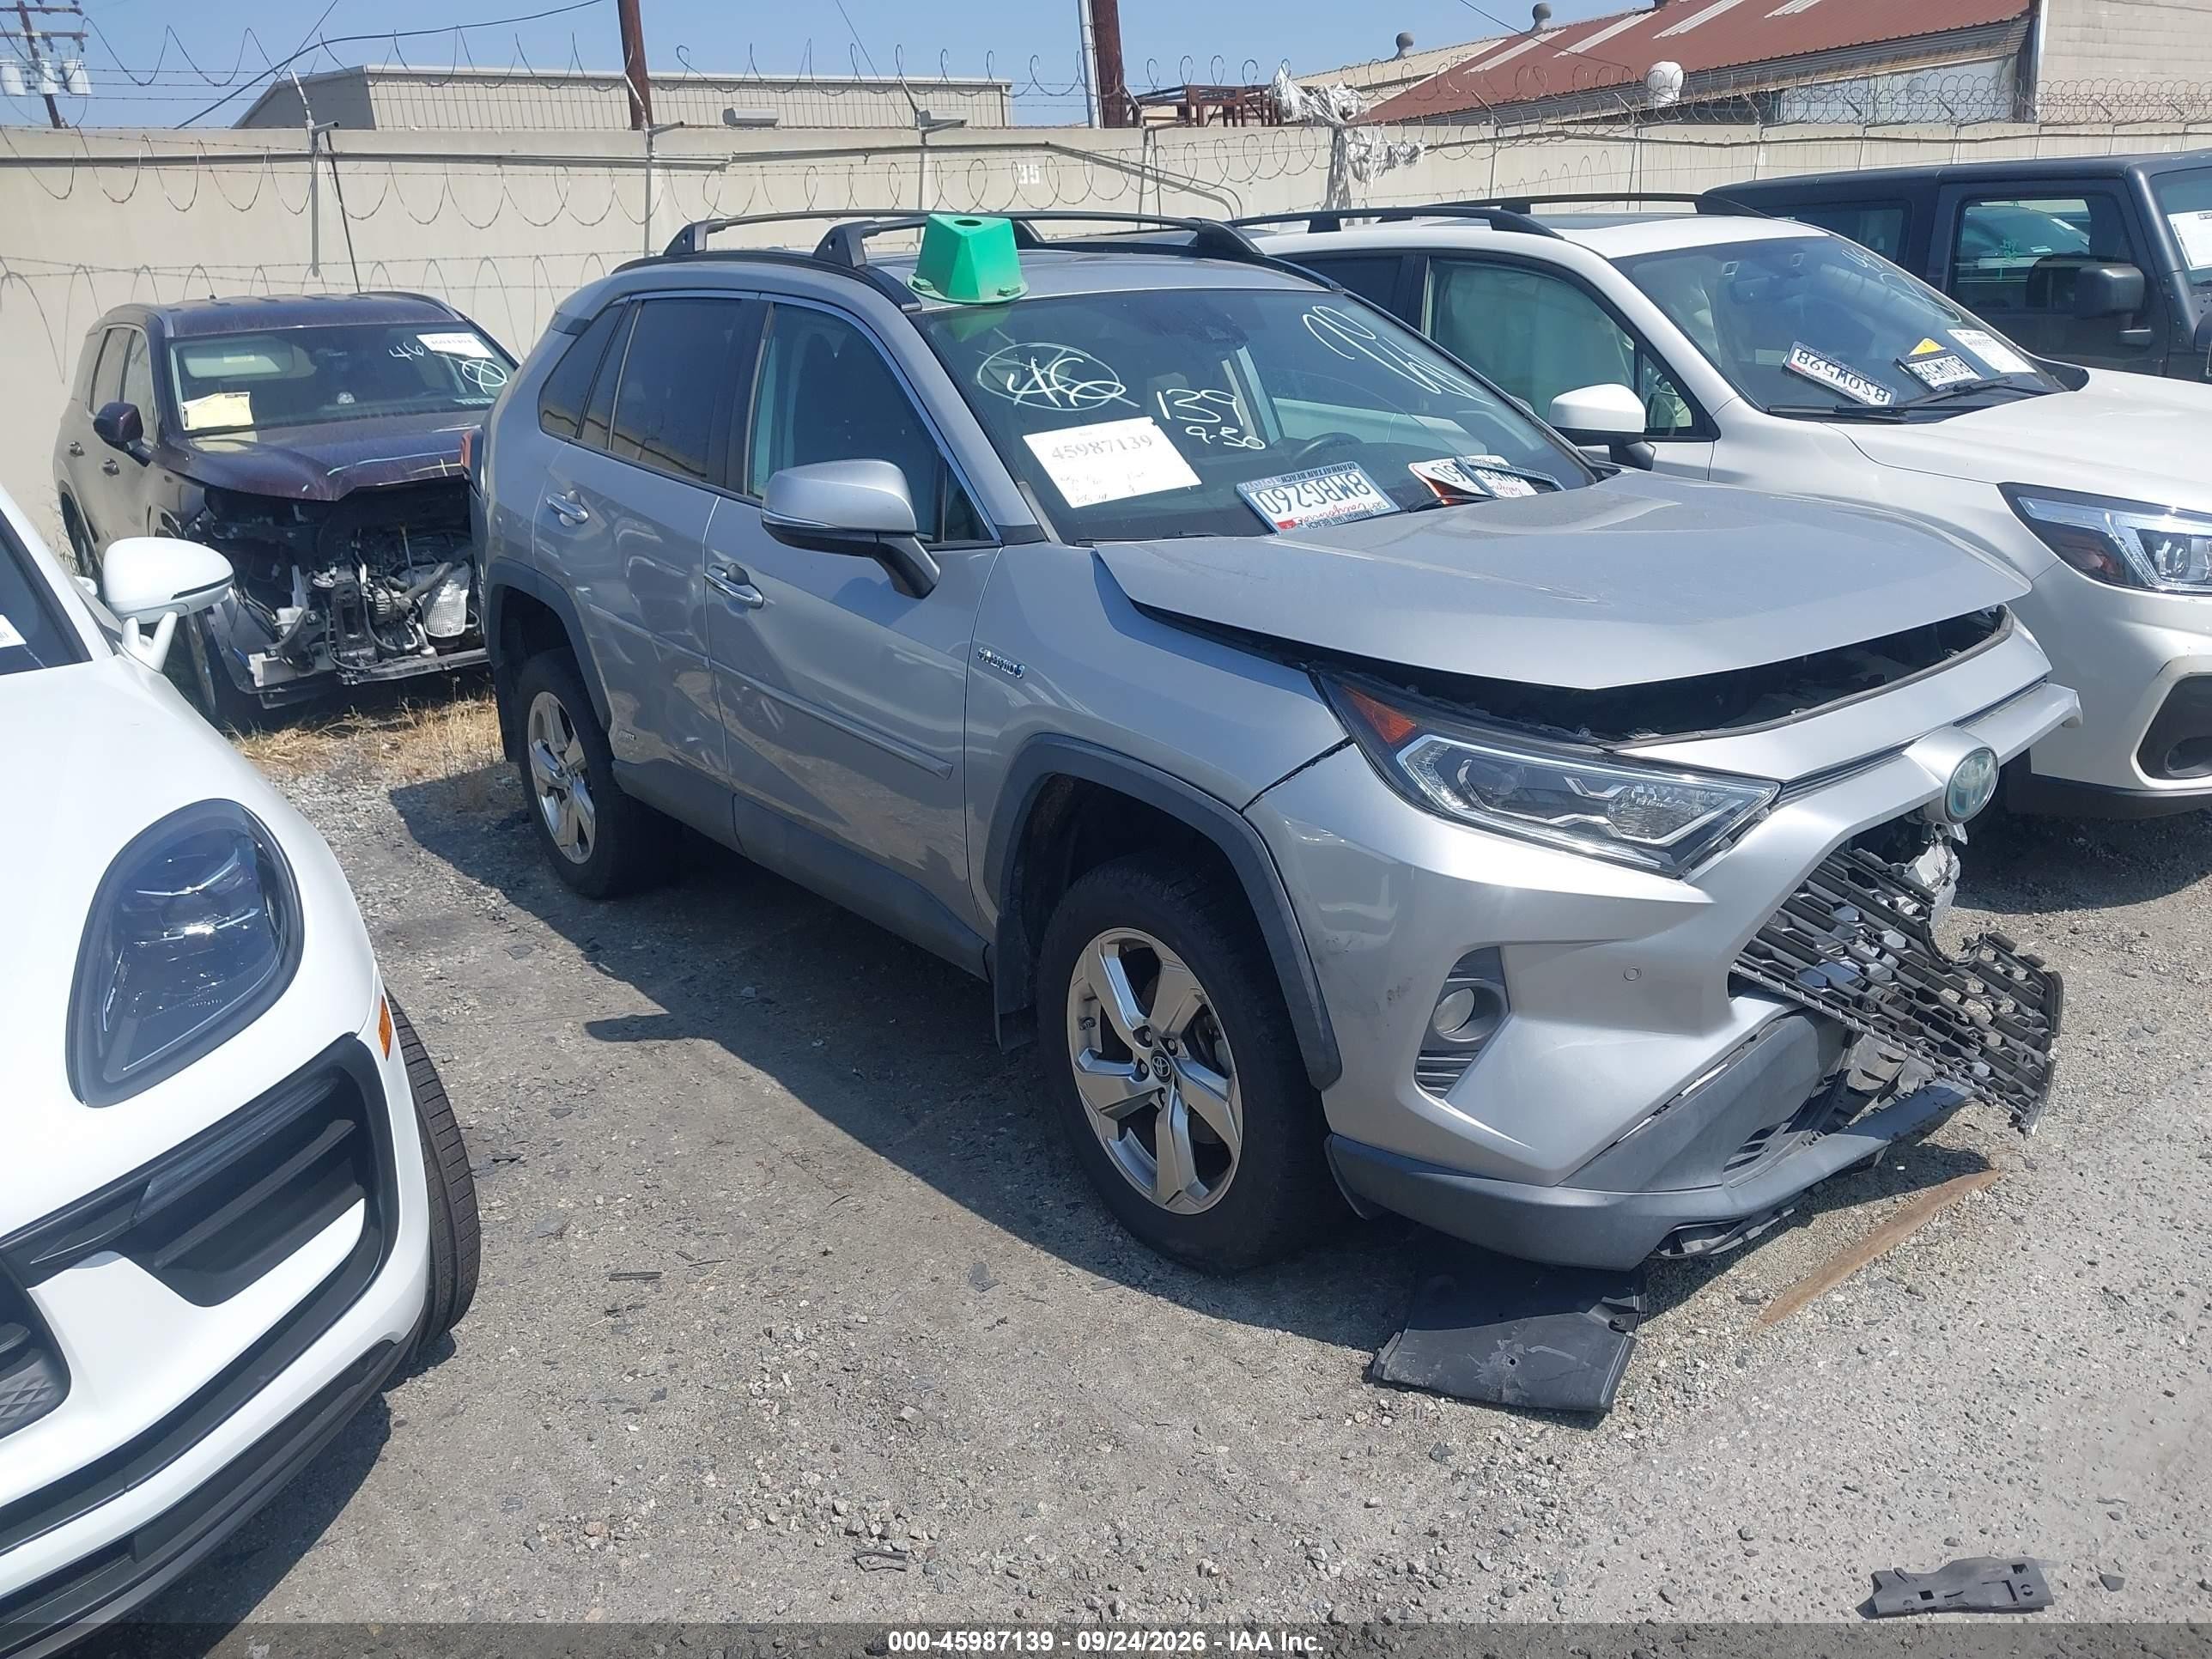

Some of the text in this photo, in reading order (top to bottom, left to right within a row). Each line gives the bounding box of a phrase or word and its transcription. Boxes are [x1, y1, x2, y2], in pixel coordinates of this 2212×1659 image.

[1157, 389, 1244, 428] 139
[1052, 434, 1153, 459] 45987139
[1280, 471, 1306, 483] BEACH
[1306, 462, 1357, 477] MANHATTAN
[1255, 473, 1371, 514] 8MBG260
